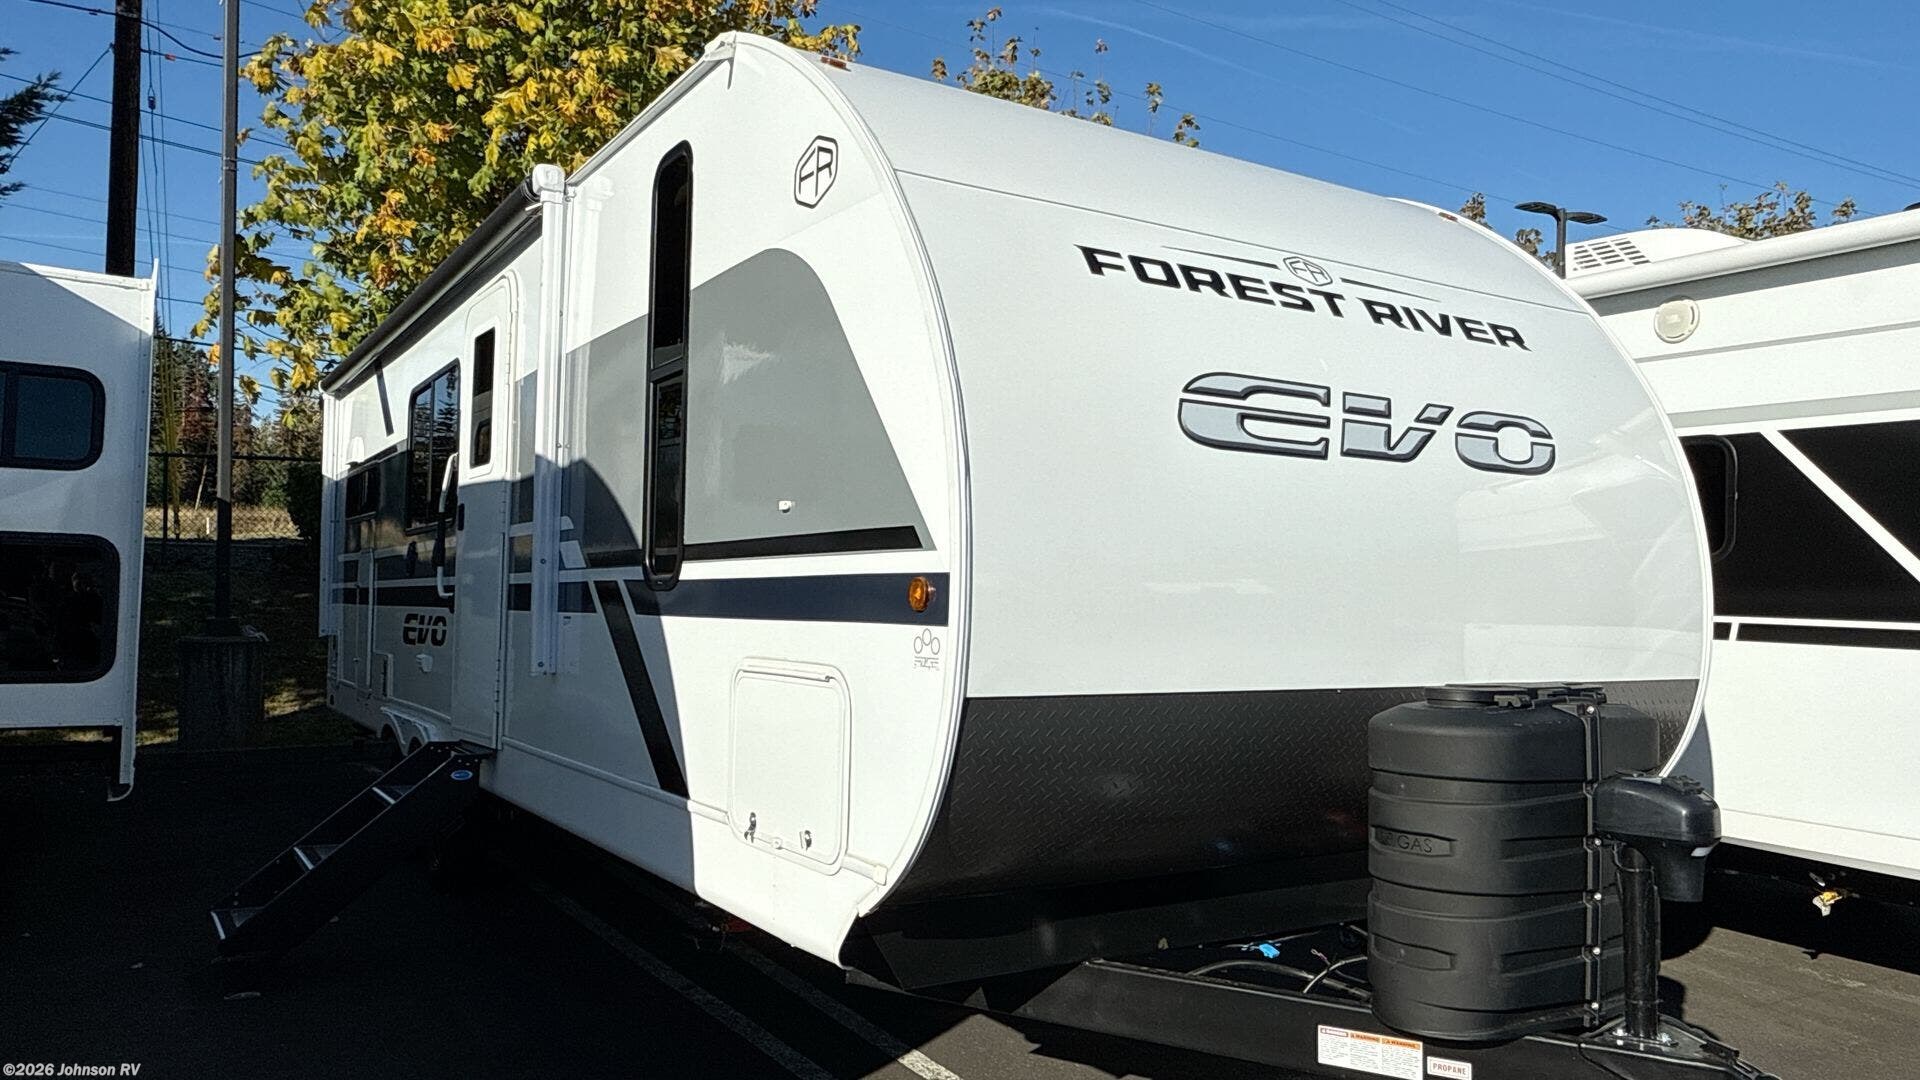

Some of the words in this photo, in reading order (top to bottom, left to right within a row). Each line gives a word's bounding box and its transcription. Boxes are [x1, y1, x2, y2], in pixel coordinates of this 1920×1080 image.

[1074, 245, 1345, 318] FOREST
[1356, 297, 1532, 352] RIVER
[1178, 371, 1556, 475] EVO
[402, 613, 447, 647] EVO
[1397, 834, 1433, 853] GAS
[1432, 1062, 1467, 1076] PROPANE
